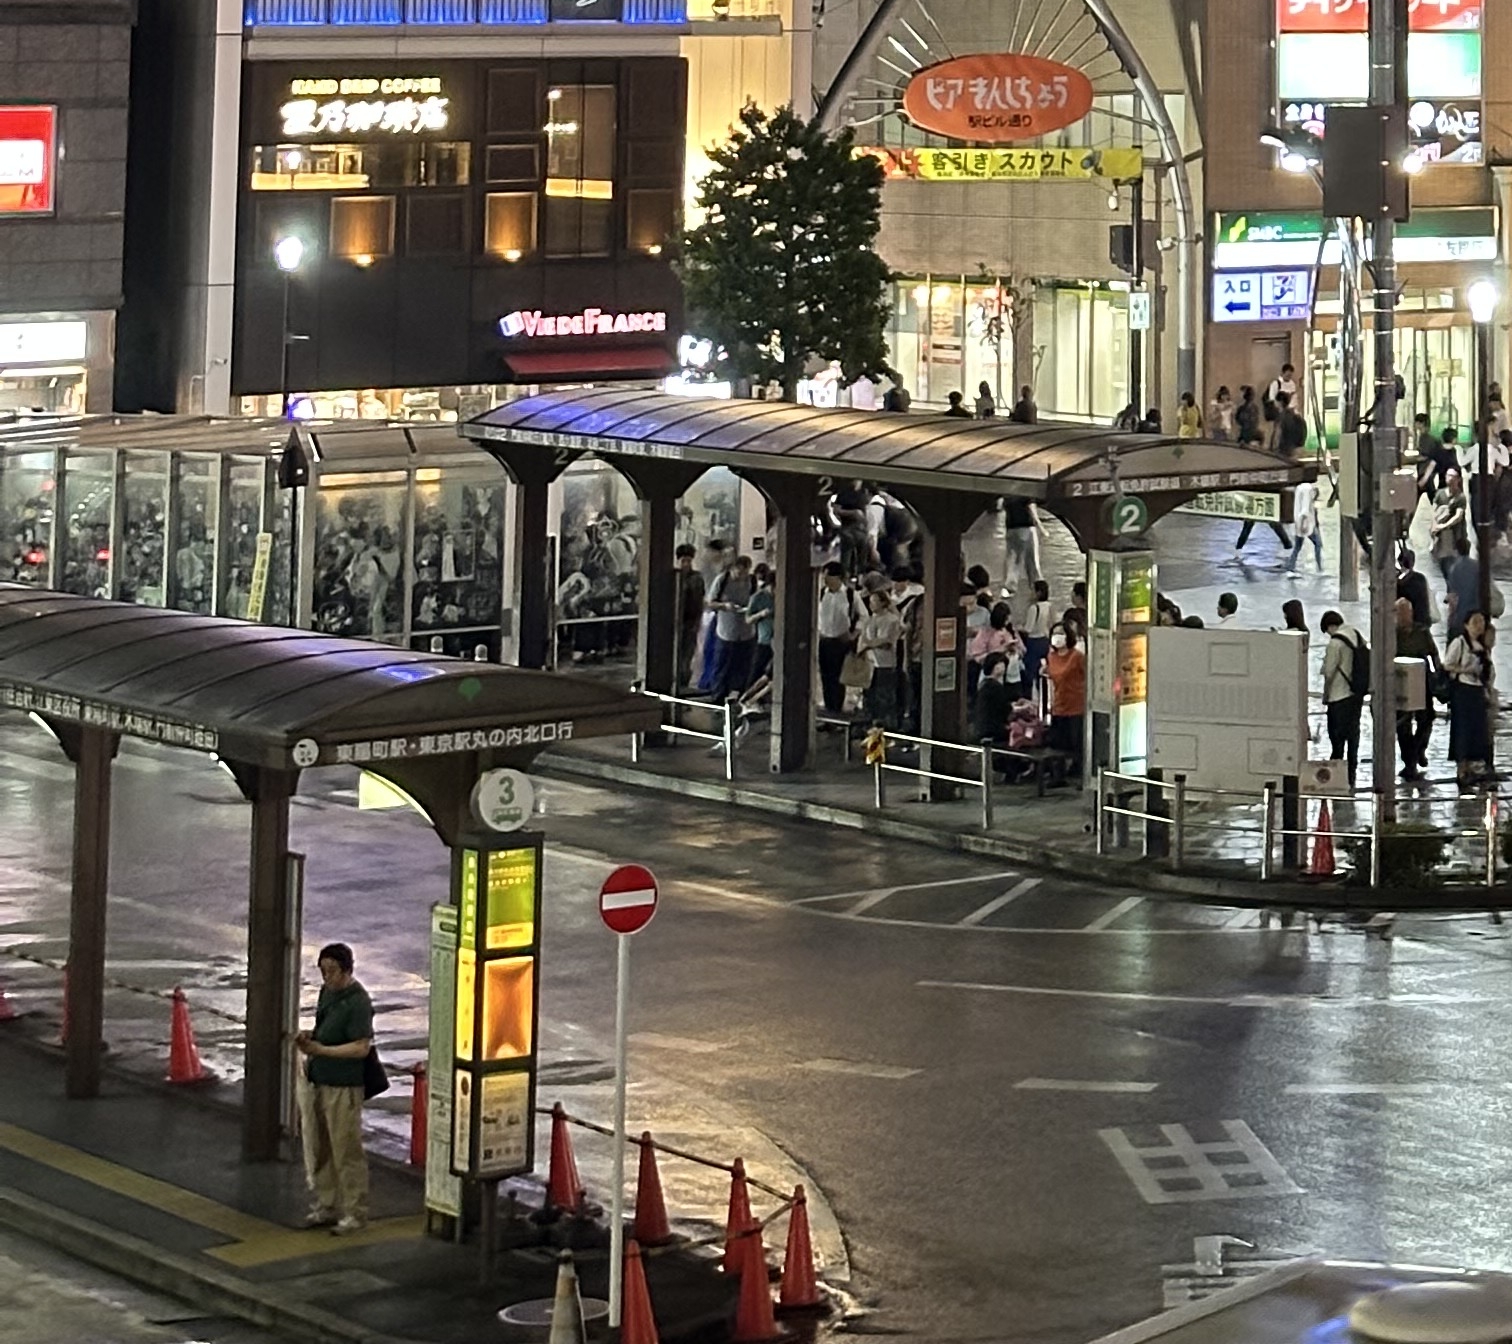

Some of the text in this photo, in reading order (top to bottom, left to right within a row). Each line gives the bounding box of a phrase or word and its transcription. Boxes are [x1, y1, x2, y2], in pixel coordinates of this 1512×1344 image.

[969, 76, 1068, 110] きんしちょう
[932, 152, 989, 171] 客引き
[999, 151, 1074, 171] スカウト
[1224, 279, 1251, 294] 入口
[555, 449, 569, 465] 2
[818, 476, 833, 497] 2
[1120, 505, 1141, 533] 2
[499, 775, 516, 805] 3
